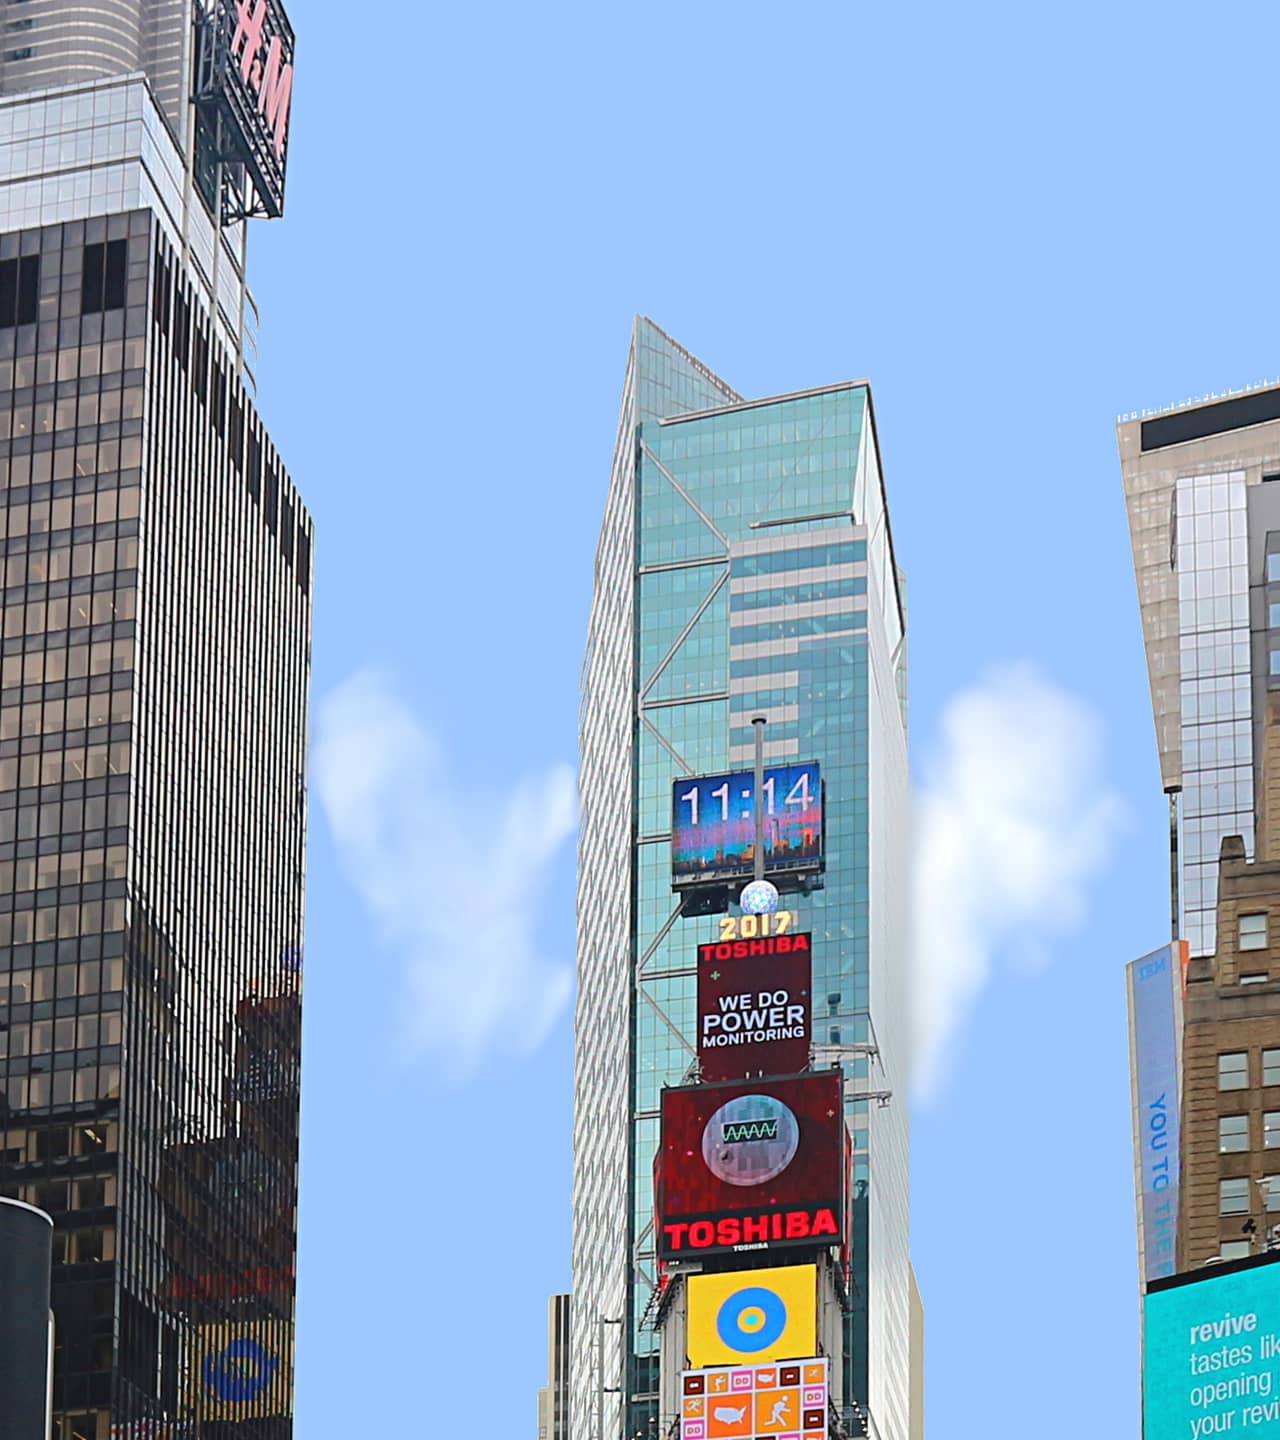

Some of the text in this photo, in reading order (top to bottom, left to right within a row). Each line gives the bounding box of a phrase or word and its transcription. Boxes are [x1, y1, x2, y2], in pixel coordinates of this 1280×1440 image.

[679, 772, 814, 825] 11:14
[719, 911, 792, 941] 2017
[699, 934, 809, 961] TOSHIBA
[718, 989, 789, 1012] WE DO
[702, 1004, 806, 1035] POWER
[701, 1025, 806, 1049] MONITORING
[1149, 1091, 1167, 1151] YOU
[662, 1207, 840, 1252] TOSHIBA
[1189, 1310, 1257, 1345] revive
[1189, 1343, 1253, 1376] tastes
[1189, 1370, 1273, 1413] opening
